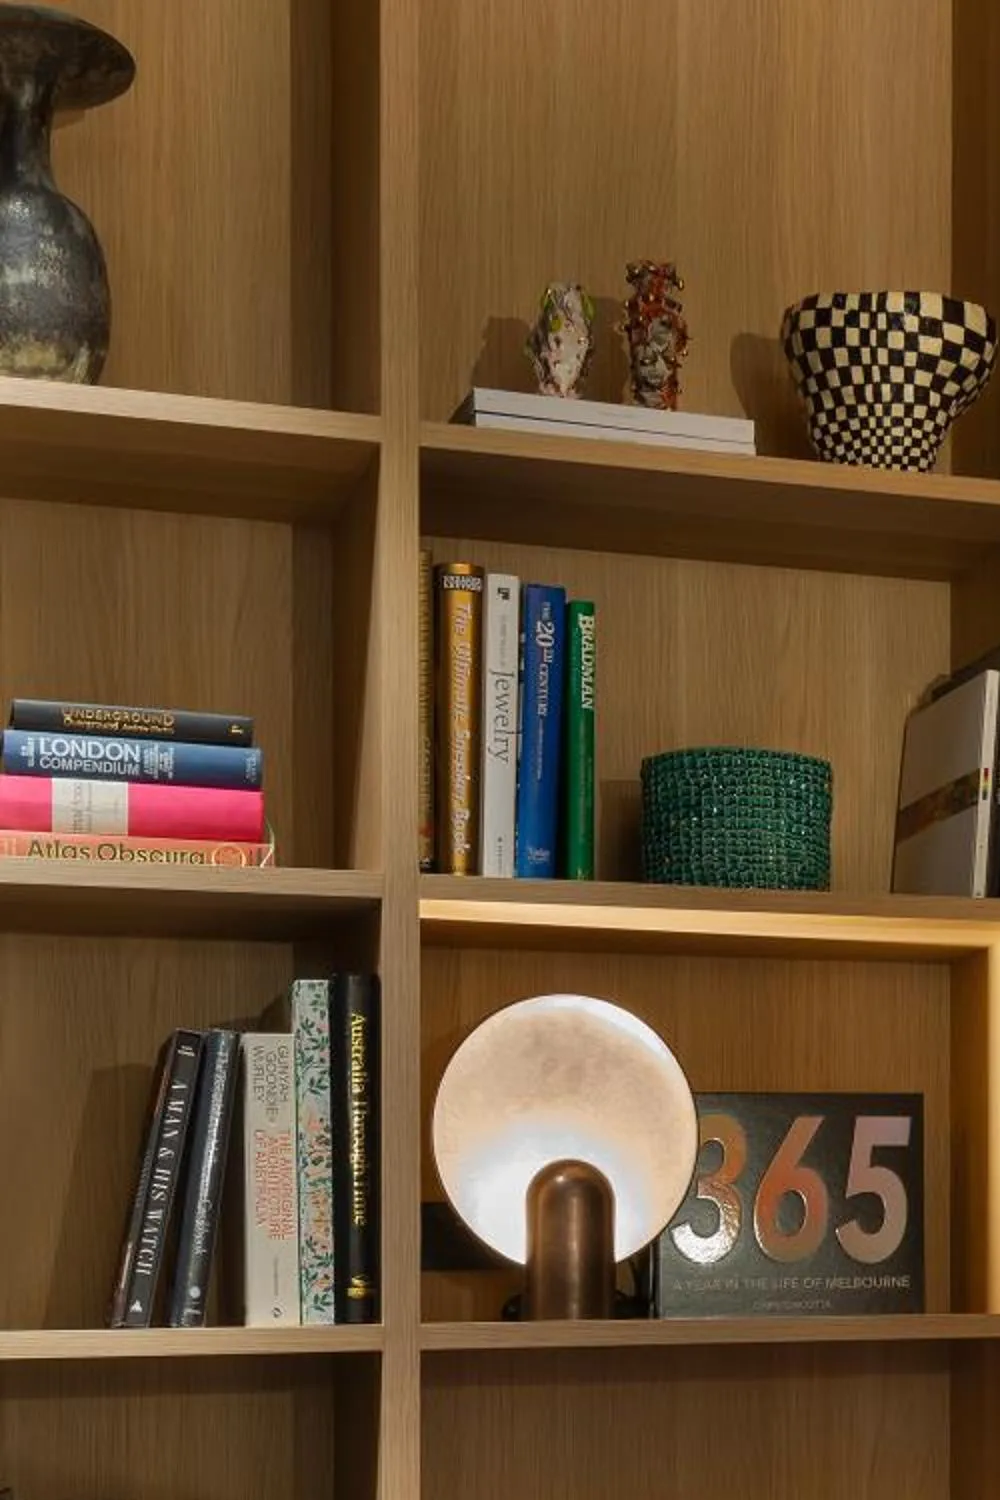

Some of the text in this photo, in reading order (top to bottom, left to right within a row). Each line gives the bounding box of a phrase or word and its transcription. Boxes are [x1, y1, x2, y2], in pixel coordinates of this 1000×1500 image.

[577, 612, 596, 710] BRADMAN
[61, 707, 175, 728] UNDERGROUND
[487, 668, 520, 765] Jewelry
[39, 756, 140, 776] COMPENDIUM
[40, 737, 140, 763] LONDON
[27, 839, 205, 865] Atlas Obscura
[350, 1012, 368, 1094] Australia
[171, 1078, 187, 1089] A
[276, 1045, 290, 1102] GUNYAH
[162, 1099, 186, 1139] MAN
[150, 1168, 172, 1201] HIS
[670, 1114, 912, 1264] 365
[135, 1208, 164, 1276] WATCH
[803, 1276, 822, 1289] OF
[825, 1275, 911, 1289] MELBOURNE
